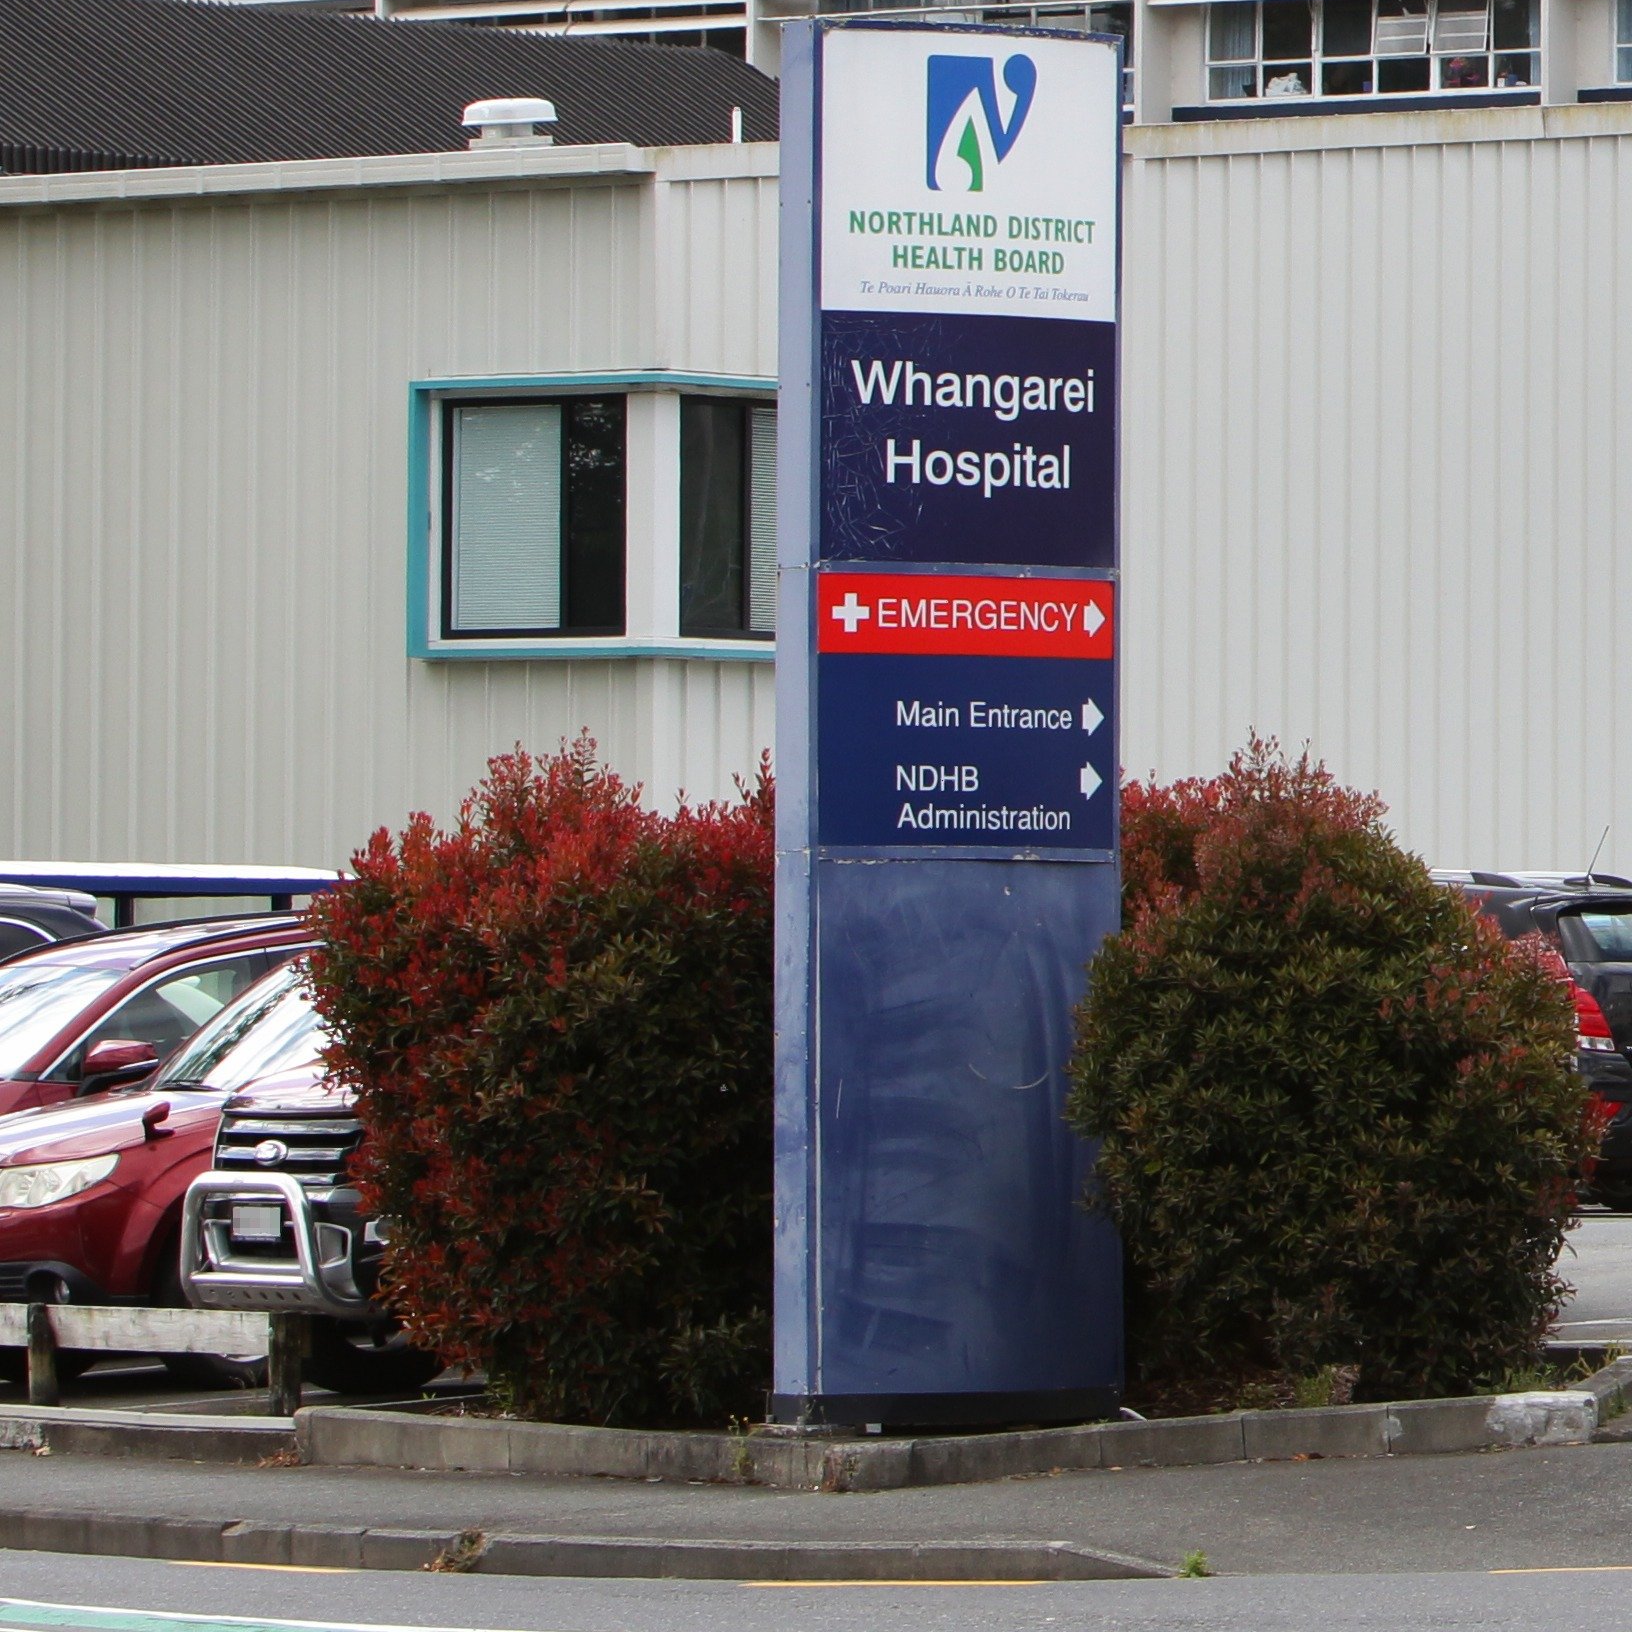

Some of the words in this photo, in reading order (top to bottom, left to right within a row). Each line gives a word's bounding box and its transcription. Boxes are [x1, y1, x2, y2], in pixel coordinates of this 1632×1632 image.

[849, 210, 997, 238] NORTHLAND
[1008, 217, 1096, 244] DISTRICT
[892, 244, 984, 270] HEALTH
[994, 249, 1065, 275] BOARD
[861, 281, 875, 294] Te
[878, 281, 912, 294] Poari
[914, 282, 960, 296] Hauora
[975, 285, 1003, 298] Rohe
[1006, 286, 1016, 299] O
[1020, 286, 1031, 299] Te
[1033, 287, 1049, 299] Tai
[851, 360, 1095, 421] Whangarei
[886, 439, 1071, 498] Hospital
[878, 598, 1078, 632] EMERGENCY
[896, 700, 959, 727] Main
[970, 701, 1072, 730] Entrance
[896, 766, 979, 792] NDHB
[897, 803, 1071, 830] Administration
